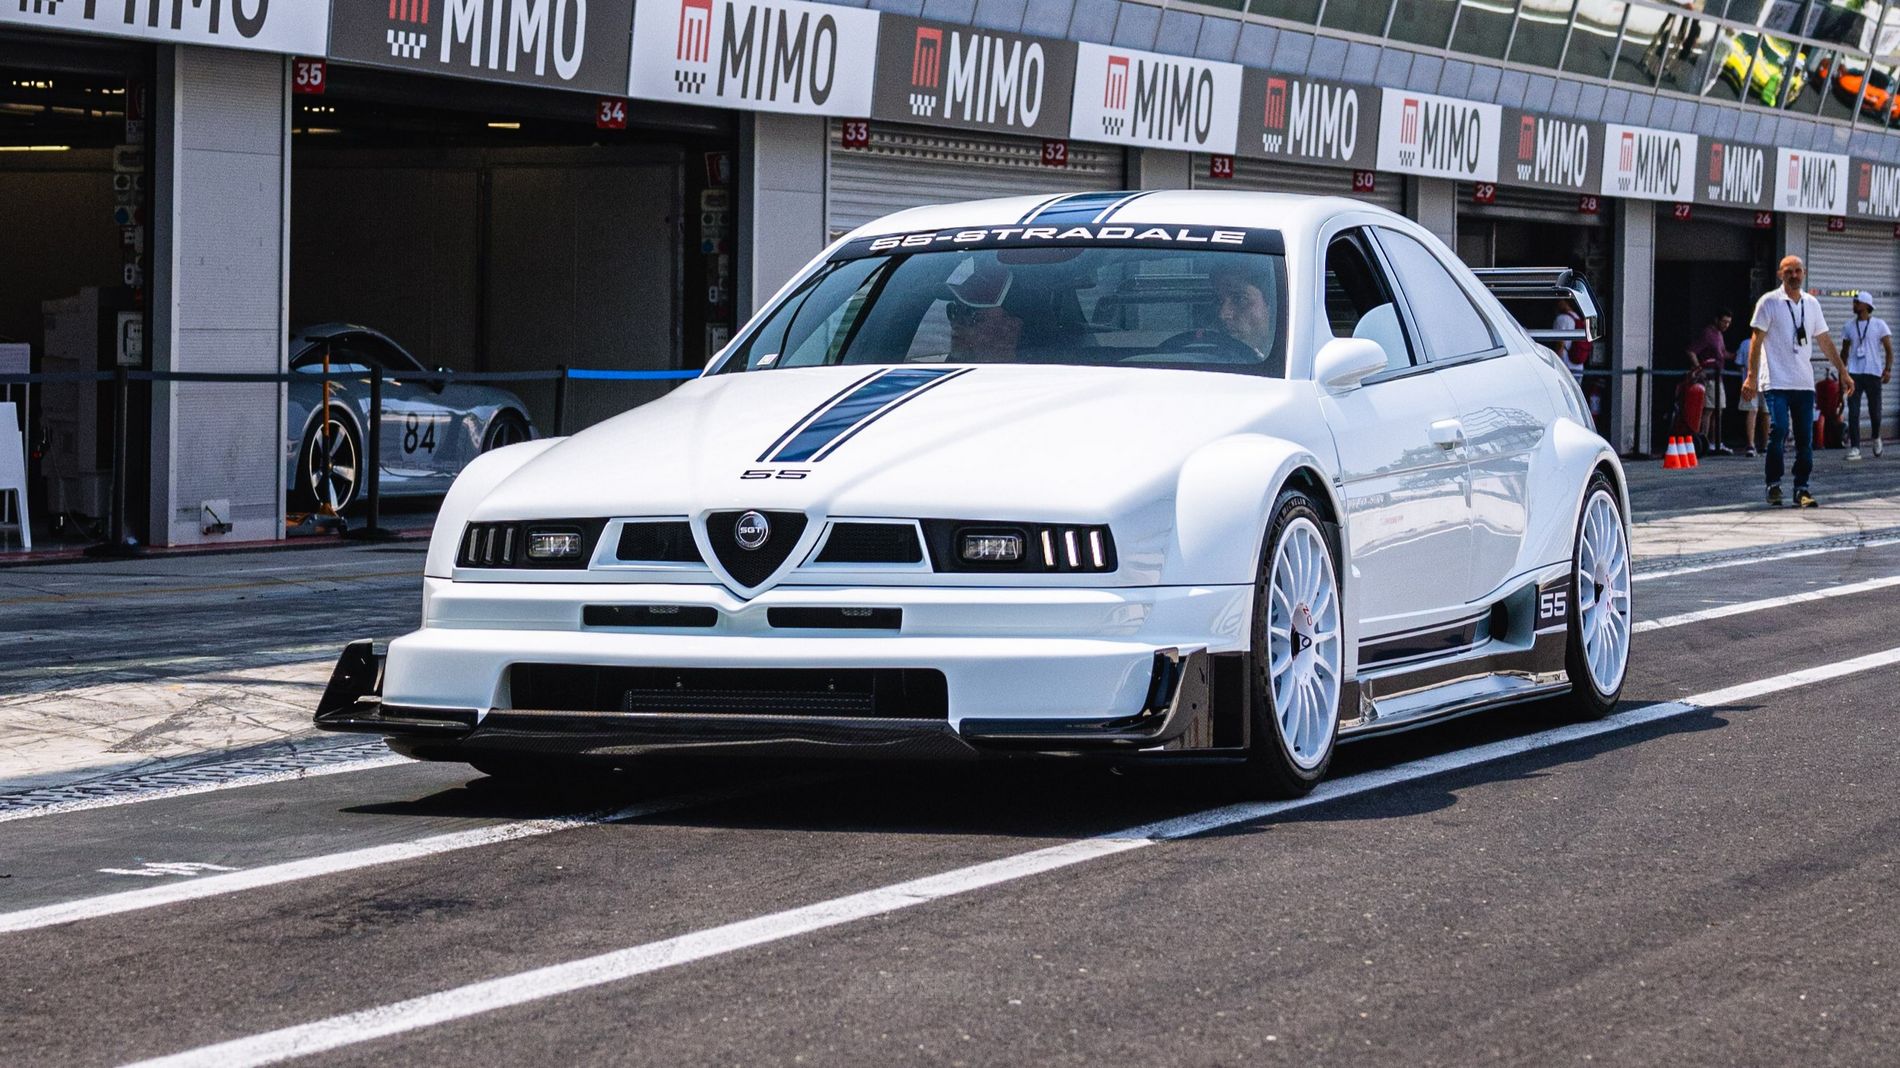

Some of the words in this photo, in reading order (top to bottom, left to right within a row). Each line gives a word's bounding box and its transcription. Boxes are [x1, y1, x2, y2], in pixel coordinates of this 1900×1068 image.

[440, 0, 587, 80] MIMO
[717, 2, 838, 106] MIMO
[297, 63, 322, 85] 35
[944, 31, 1044, 128] MIMO
[600, 101, 624, 122] 34
[1131, 59, 1214, 145] MIMO
[846, 122, 867, 141] 33
[1287, 81, 1359, 161] MIMO
[1420, 101, 1480, 174] MIMO
[1045, 143, 1065, 160] 32
[1534, 117, 1589, 188] MIMO
[1213, 157, 1231, 173] 31
[1634, 133, 1682, 196] MIMO
[1721, 144, 1764, 205] MIMO
[1355, 172, 1374, 187] 30
[1476, 184, 1495, 198] 29
[1800, 155, 1837, 210] MIMO
[1868, 164, 1900, 218] MIMO
[1581, 196, 1597, 210] 28
[1675, 204, 1690, 217] 27
[1756, 213, 1771, 225] 26
[869, 227, 1247, 251] 55-STRADALE
[404, 413, 436, 454] 84
[740, 469, 811, 480] 55
[740, 526, 763, 534] SGT
[1541, 592, 1567, 619] 55
